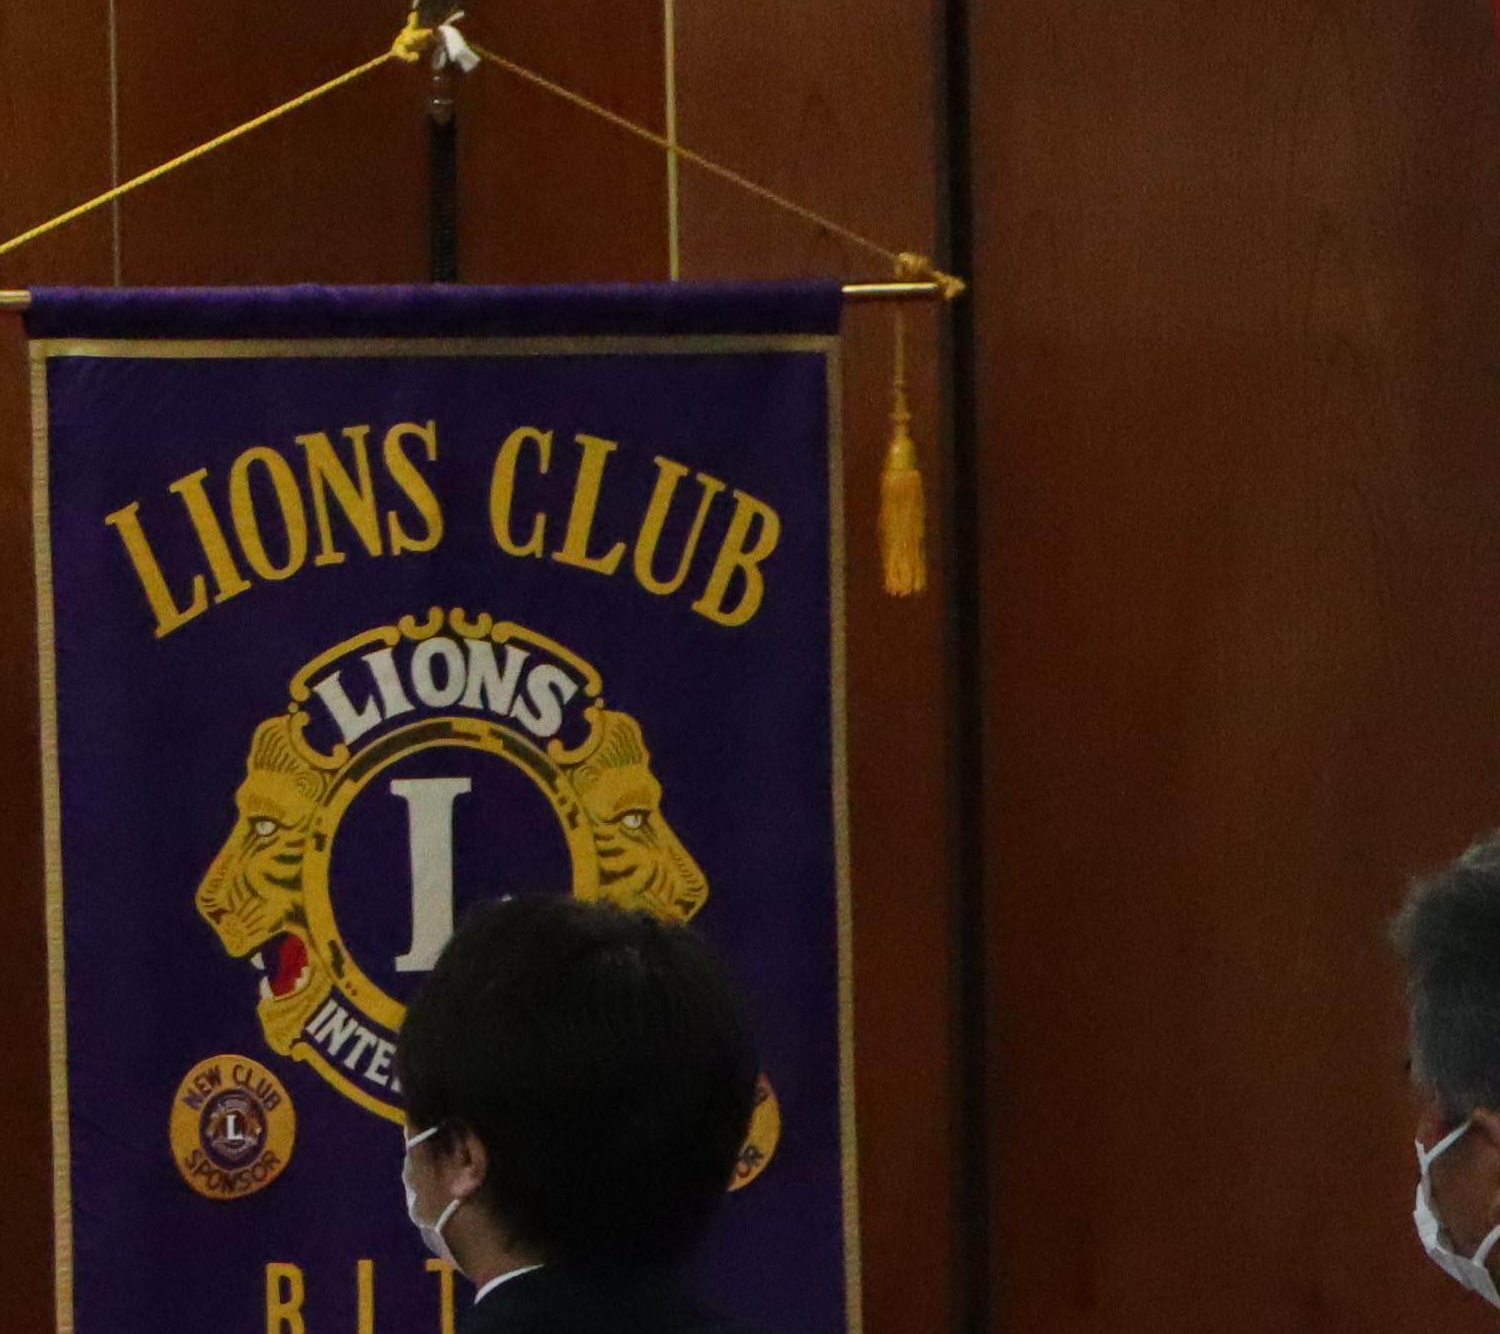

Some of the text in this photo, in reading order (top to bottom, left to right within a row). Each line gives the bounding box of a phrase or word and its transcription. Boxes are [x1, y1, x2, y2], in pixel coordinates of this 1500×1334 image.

[104, 419, 781, 640] LIONS CLUB
[312, 636, 580, 747] LIONS
[305, 998, 403, 1093] INTE
[182, 1064, 283, 1112] NEW CLUB
[226, 1114, 245, 1141] L
[184, 1148, 282, 1194] SPONSOR
